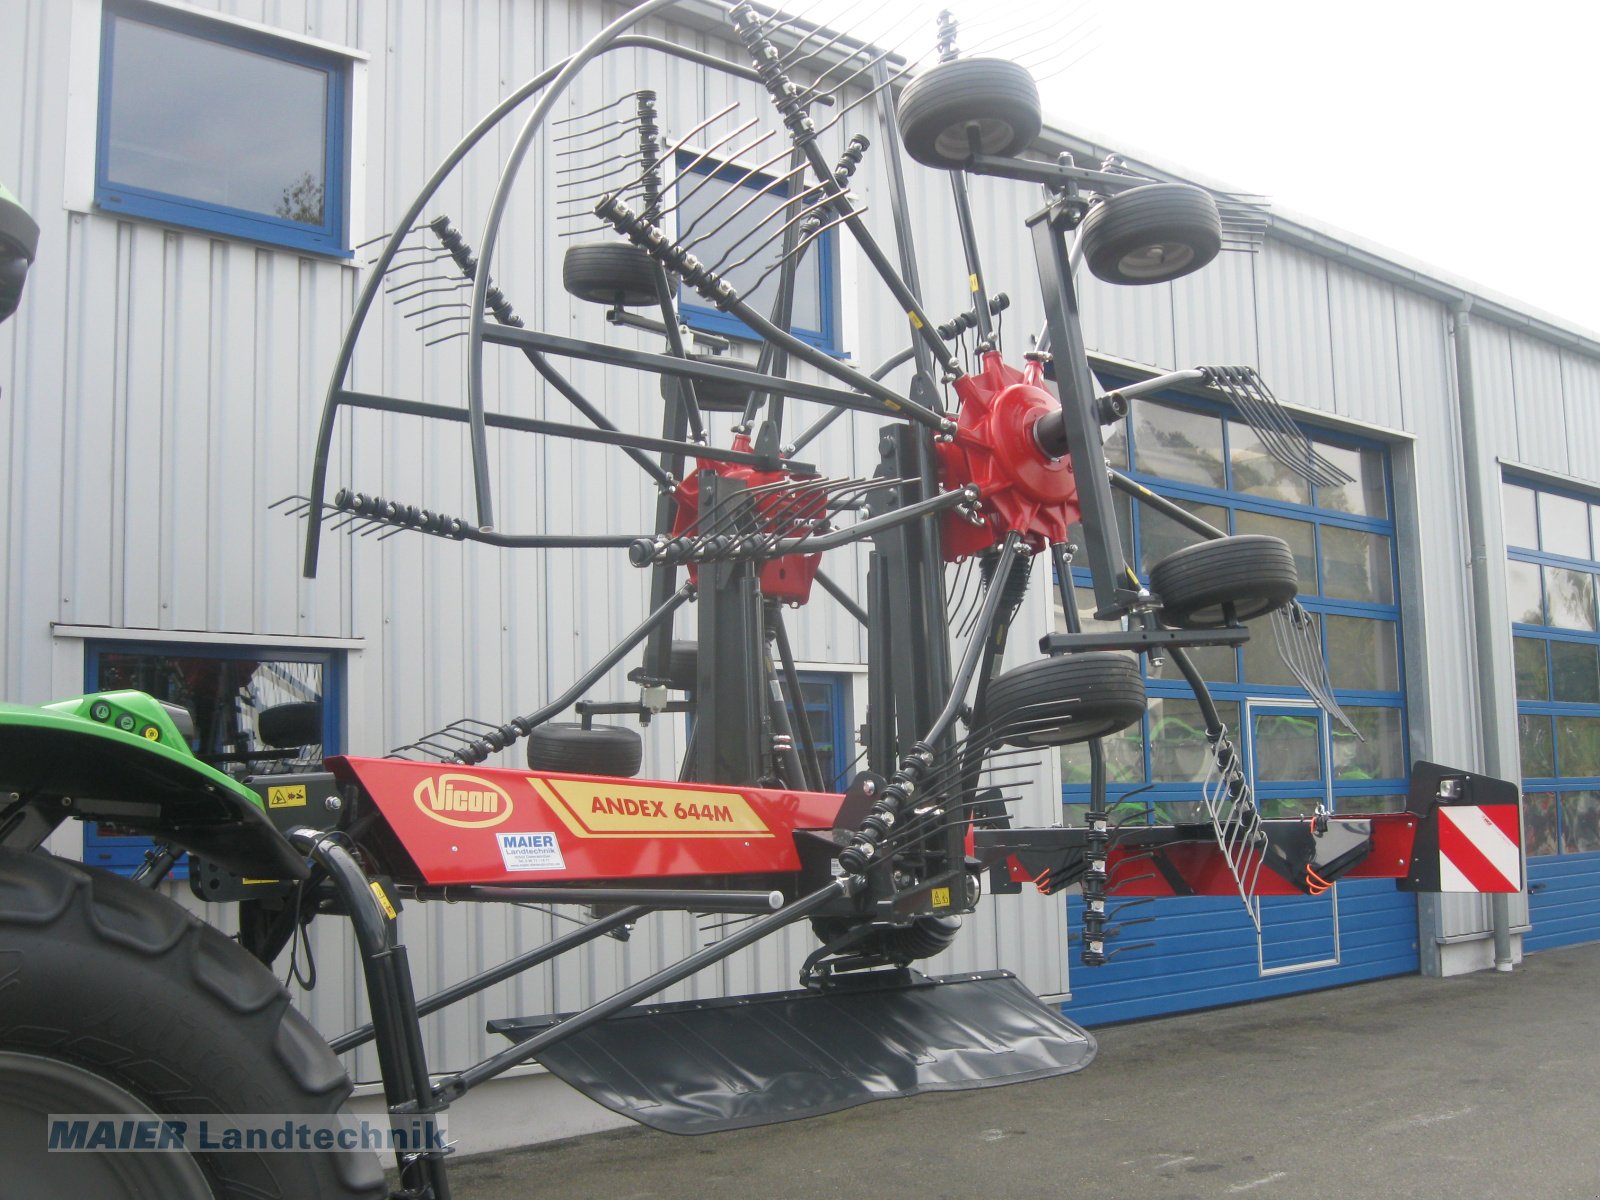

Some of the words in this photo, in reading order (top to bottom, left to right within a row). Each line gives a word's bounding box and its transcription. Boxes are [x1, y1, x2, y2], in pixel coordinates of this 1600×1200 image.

[427, 775, 498, 813] Vicon
[591, 796, 669, 818] ANDEX
[674, 803, 735, 823] 644M
[503, 835, 554, 848] MAIER
[505, 847, 556, 855] Landtechnik
